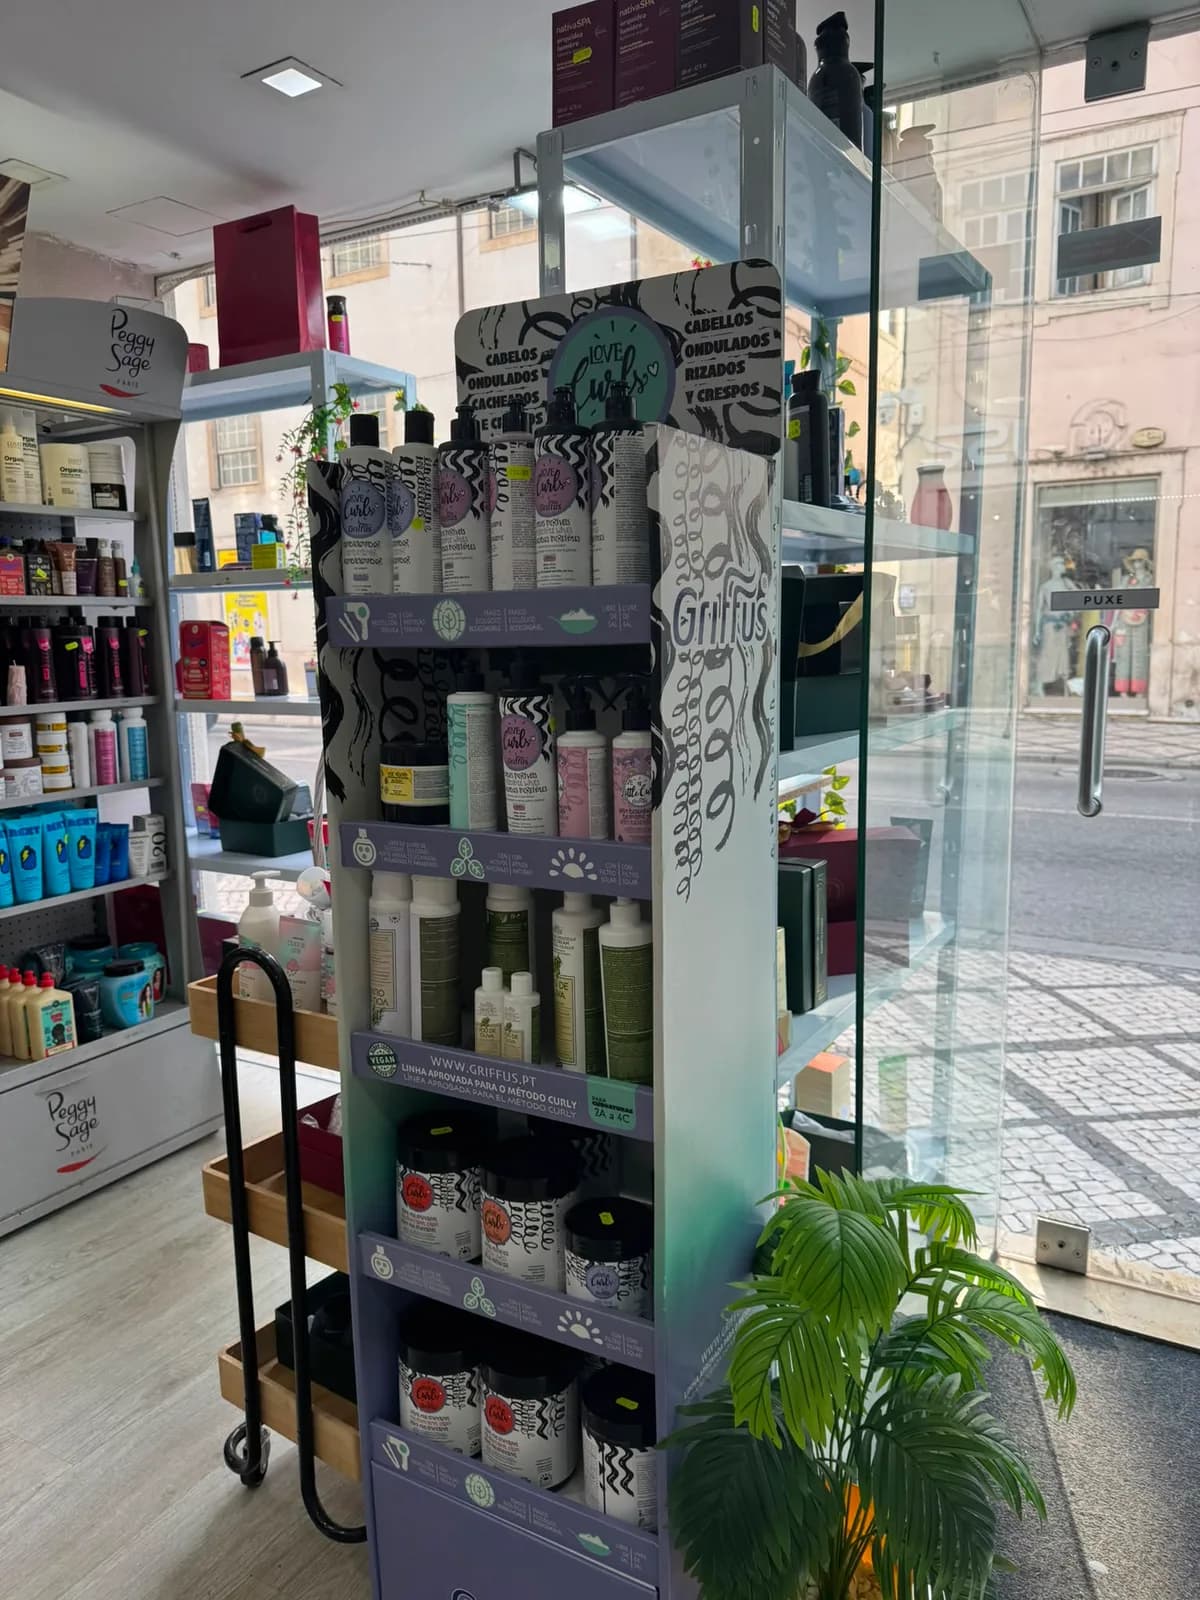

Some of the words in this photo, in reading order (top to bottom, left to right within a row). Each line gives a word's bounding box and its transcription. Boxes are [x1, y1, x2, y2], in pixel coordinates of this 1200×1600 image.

[556, 16, 592, 33] nativaSPA
[110, 308, 155, 357] Peggy
[684, 311, 754, 335] CABELLOS
[485, 347, 538, 366] CABELOS
[589, 342, 624, 365] LOVE
[684, 333, 770, 358] ONDULADOS
[105, 343, 152, 378] Sage
[684, 360, 746, 382] RIZADOS
[467, 369, 539, 390] ONDULADOS
[684, 391, 695, 405] Y
[697, 381, 760, 402] CRESPOS
[481, 418, 489, 430] E
[536, 469, 563, 497] Curls
[343, 496, 375, 520] Curls
[672, 567, 768, 646] Griffus
[1083, 594, 1124, 605] PUXE
[503, 728, 530, 750] Curls
[369, 1055, 396, 1065] VEGAN
[430, 1055, 537, 1087] WWW.GRIFFUS.PT
[401, 1063, 427, 1076] LINHA
[428, 1069, 474, 1087] APROVADA
[475, 1079, 498, 1092] PARA
[499, 1084, 506, 1093] O
[507, 1085, 546, 1102] MÉTODO
[548, 1095, 577, 1109] CURLY
[46, 1091, 97, 1126] Peggy
[594, 1107, 607, 1119] 2A
[617, 1113, 630, 1124] 4C
[55, 1118, 98, 1152] Sage
